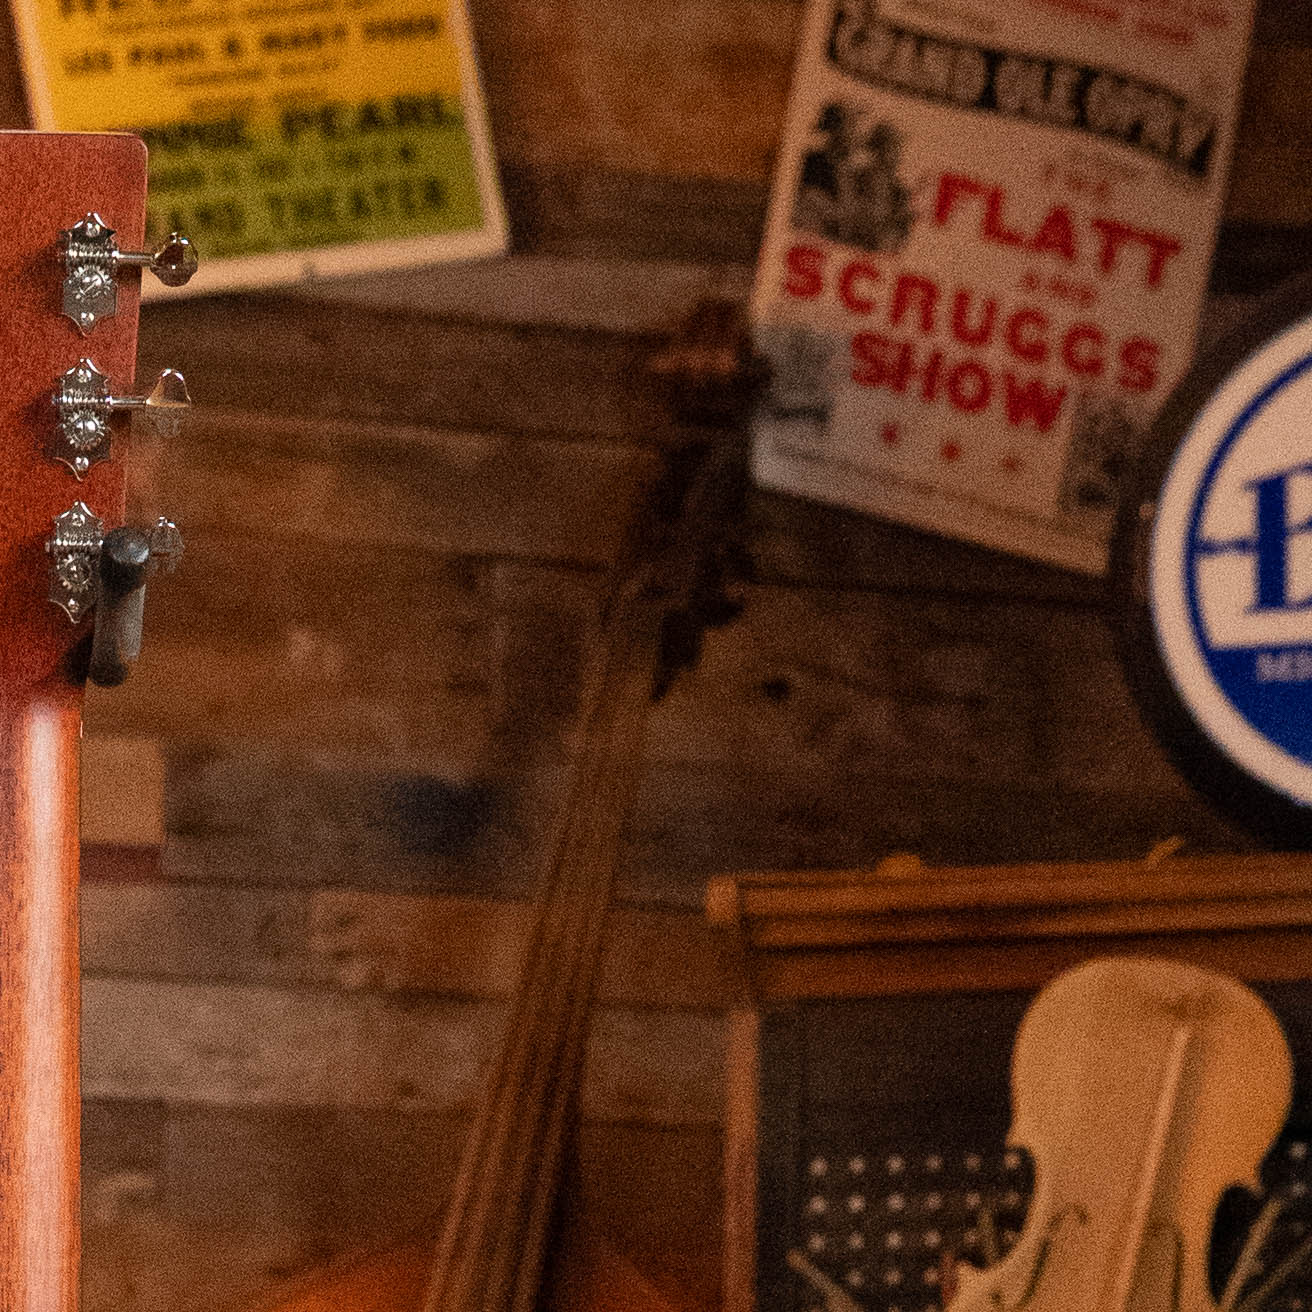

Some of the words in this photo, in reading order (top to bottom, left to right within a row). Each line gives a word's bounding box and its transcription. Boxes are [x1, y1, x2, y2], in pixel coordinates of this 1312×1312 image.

[933, 170, 1183, 290] FLATT
[783, 243, 1162, 393] SCRUGGS
[850, 330, 1068, 433] SHOW
